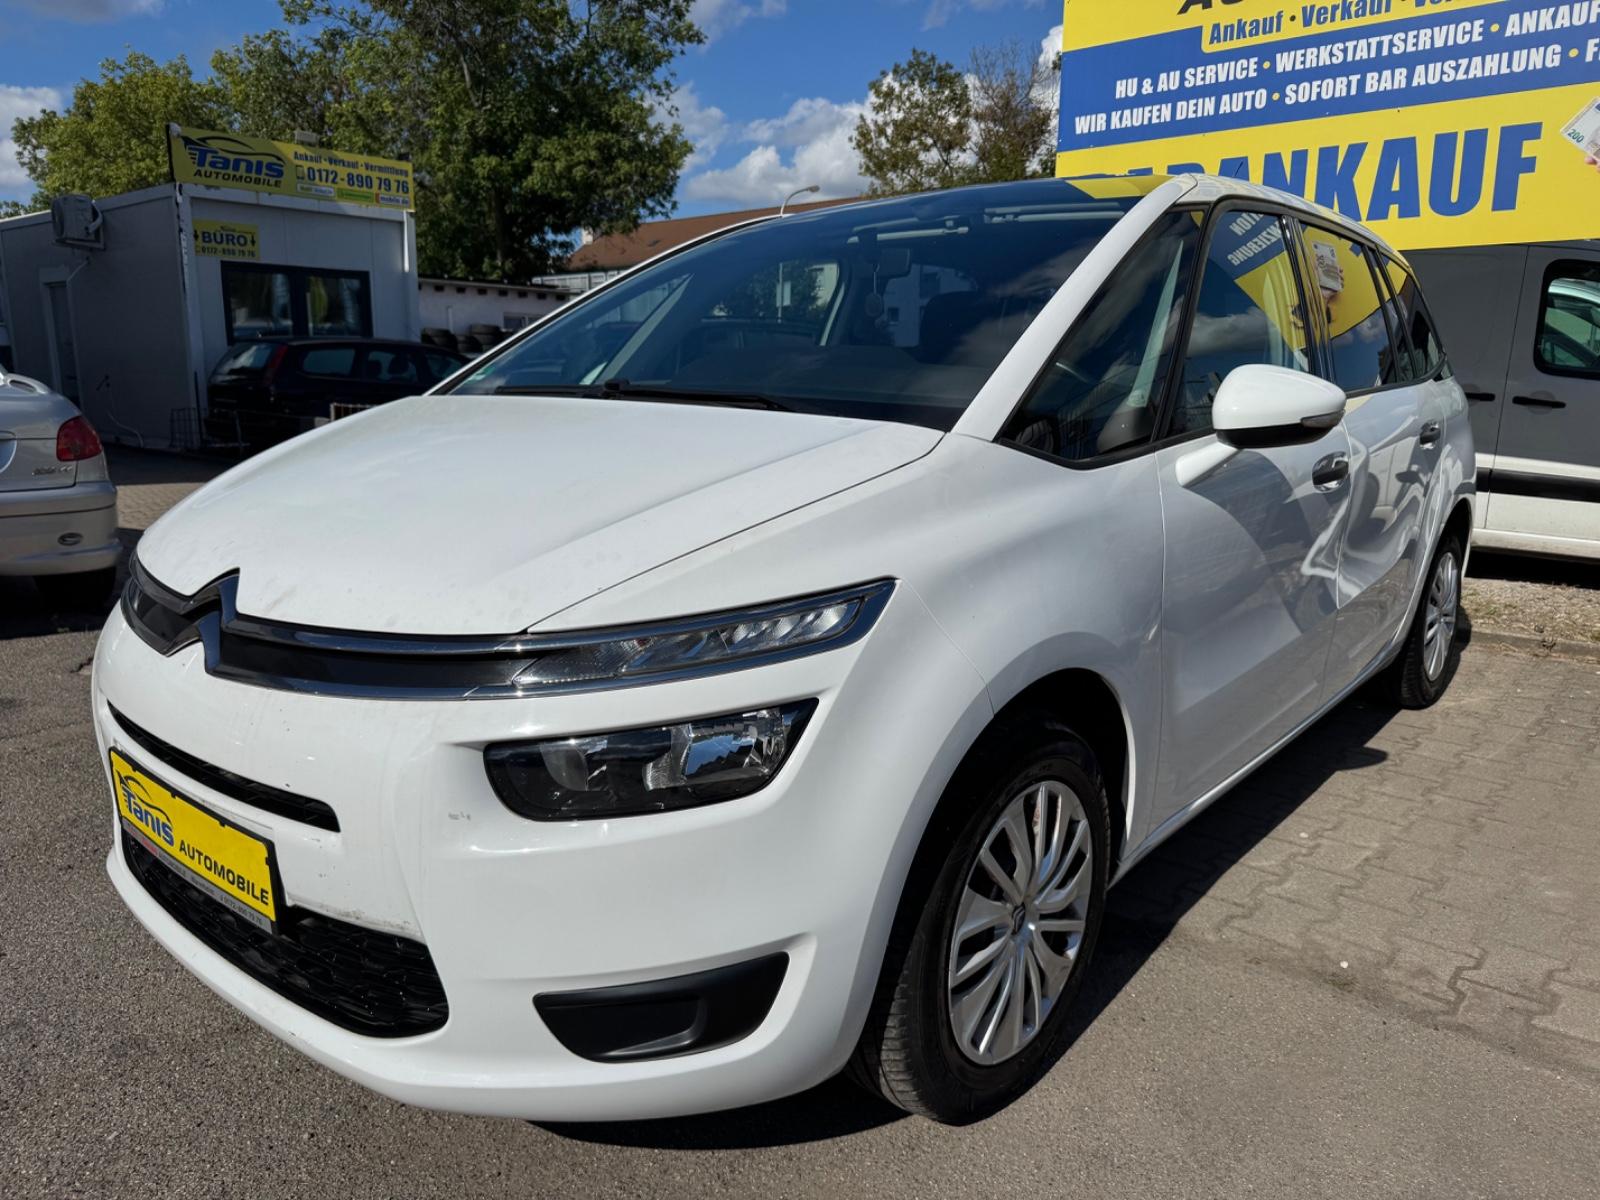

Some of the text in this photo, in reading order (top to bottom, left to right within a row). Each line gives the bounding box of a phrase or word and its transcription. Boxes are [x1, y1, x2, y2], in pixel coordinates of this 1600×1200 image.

[1209, 11, 1284, 45] Ankauf
[1115, 0, 1600, 99] HU & AU SERVICE WERKSTATTSERVICE ANKAUF
[1075, 114, 1107, 135] WIR
[1110, 103, 1172, 129] KAUFEN
[1176, 97, 1216, 121] DEIN
[1219, 88, 1267, 115] AUTO
[1285, 75, 1361, 105] SOFORT
[1364, 68, 1407, 94] BAR
[1412, 44, 1562, 87] AUSZAHLUNG
[1567, 128, 1585, 143] 200
[187, 145, 285, 179] Tanis
[193, 168, 282, 188] AUTOMOBILE
[376, 177, 392, 193] 79
[394, 180, 410, 194] 76
[121, 785, 269, 906] Tanis AUTOMOBILE
